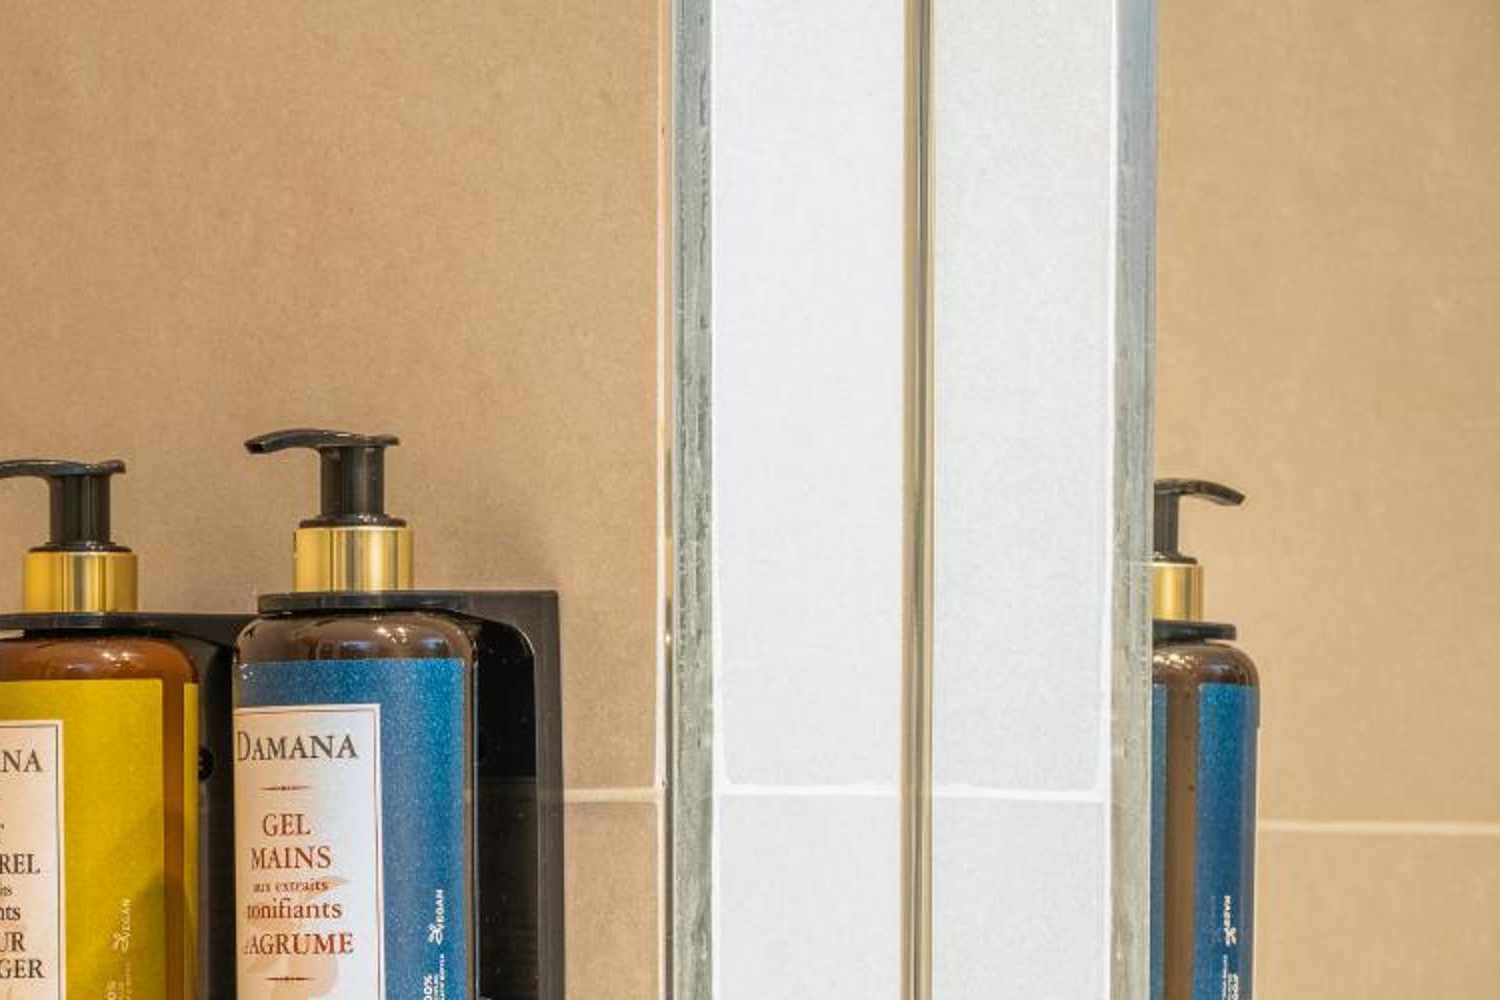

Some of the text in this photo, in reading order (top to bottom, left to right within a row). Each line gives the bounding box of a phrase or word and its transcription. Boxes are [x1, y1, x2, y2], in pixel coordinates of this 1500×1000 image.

[237, 731, 358, 761] DAMANA
[263, 813, 311, 837] GEL
[251, 845, 332, 870] MAINS
[275, 878, 329, 893] extraits
[436, 889, 444, 930] VEGAN
